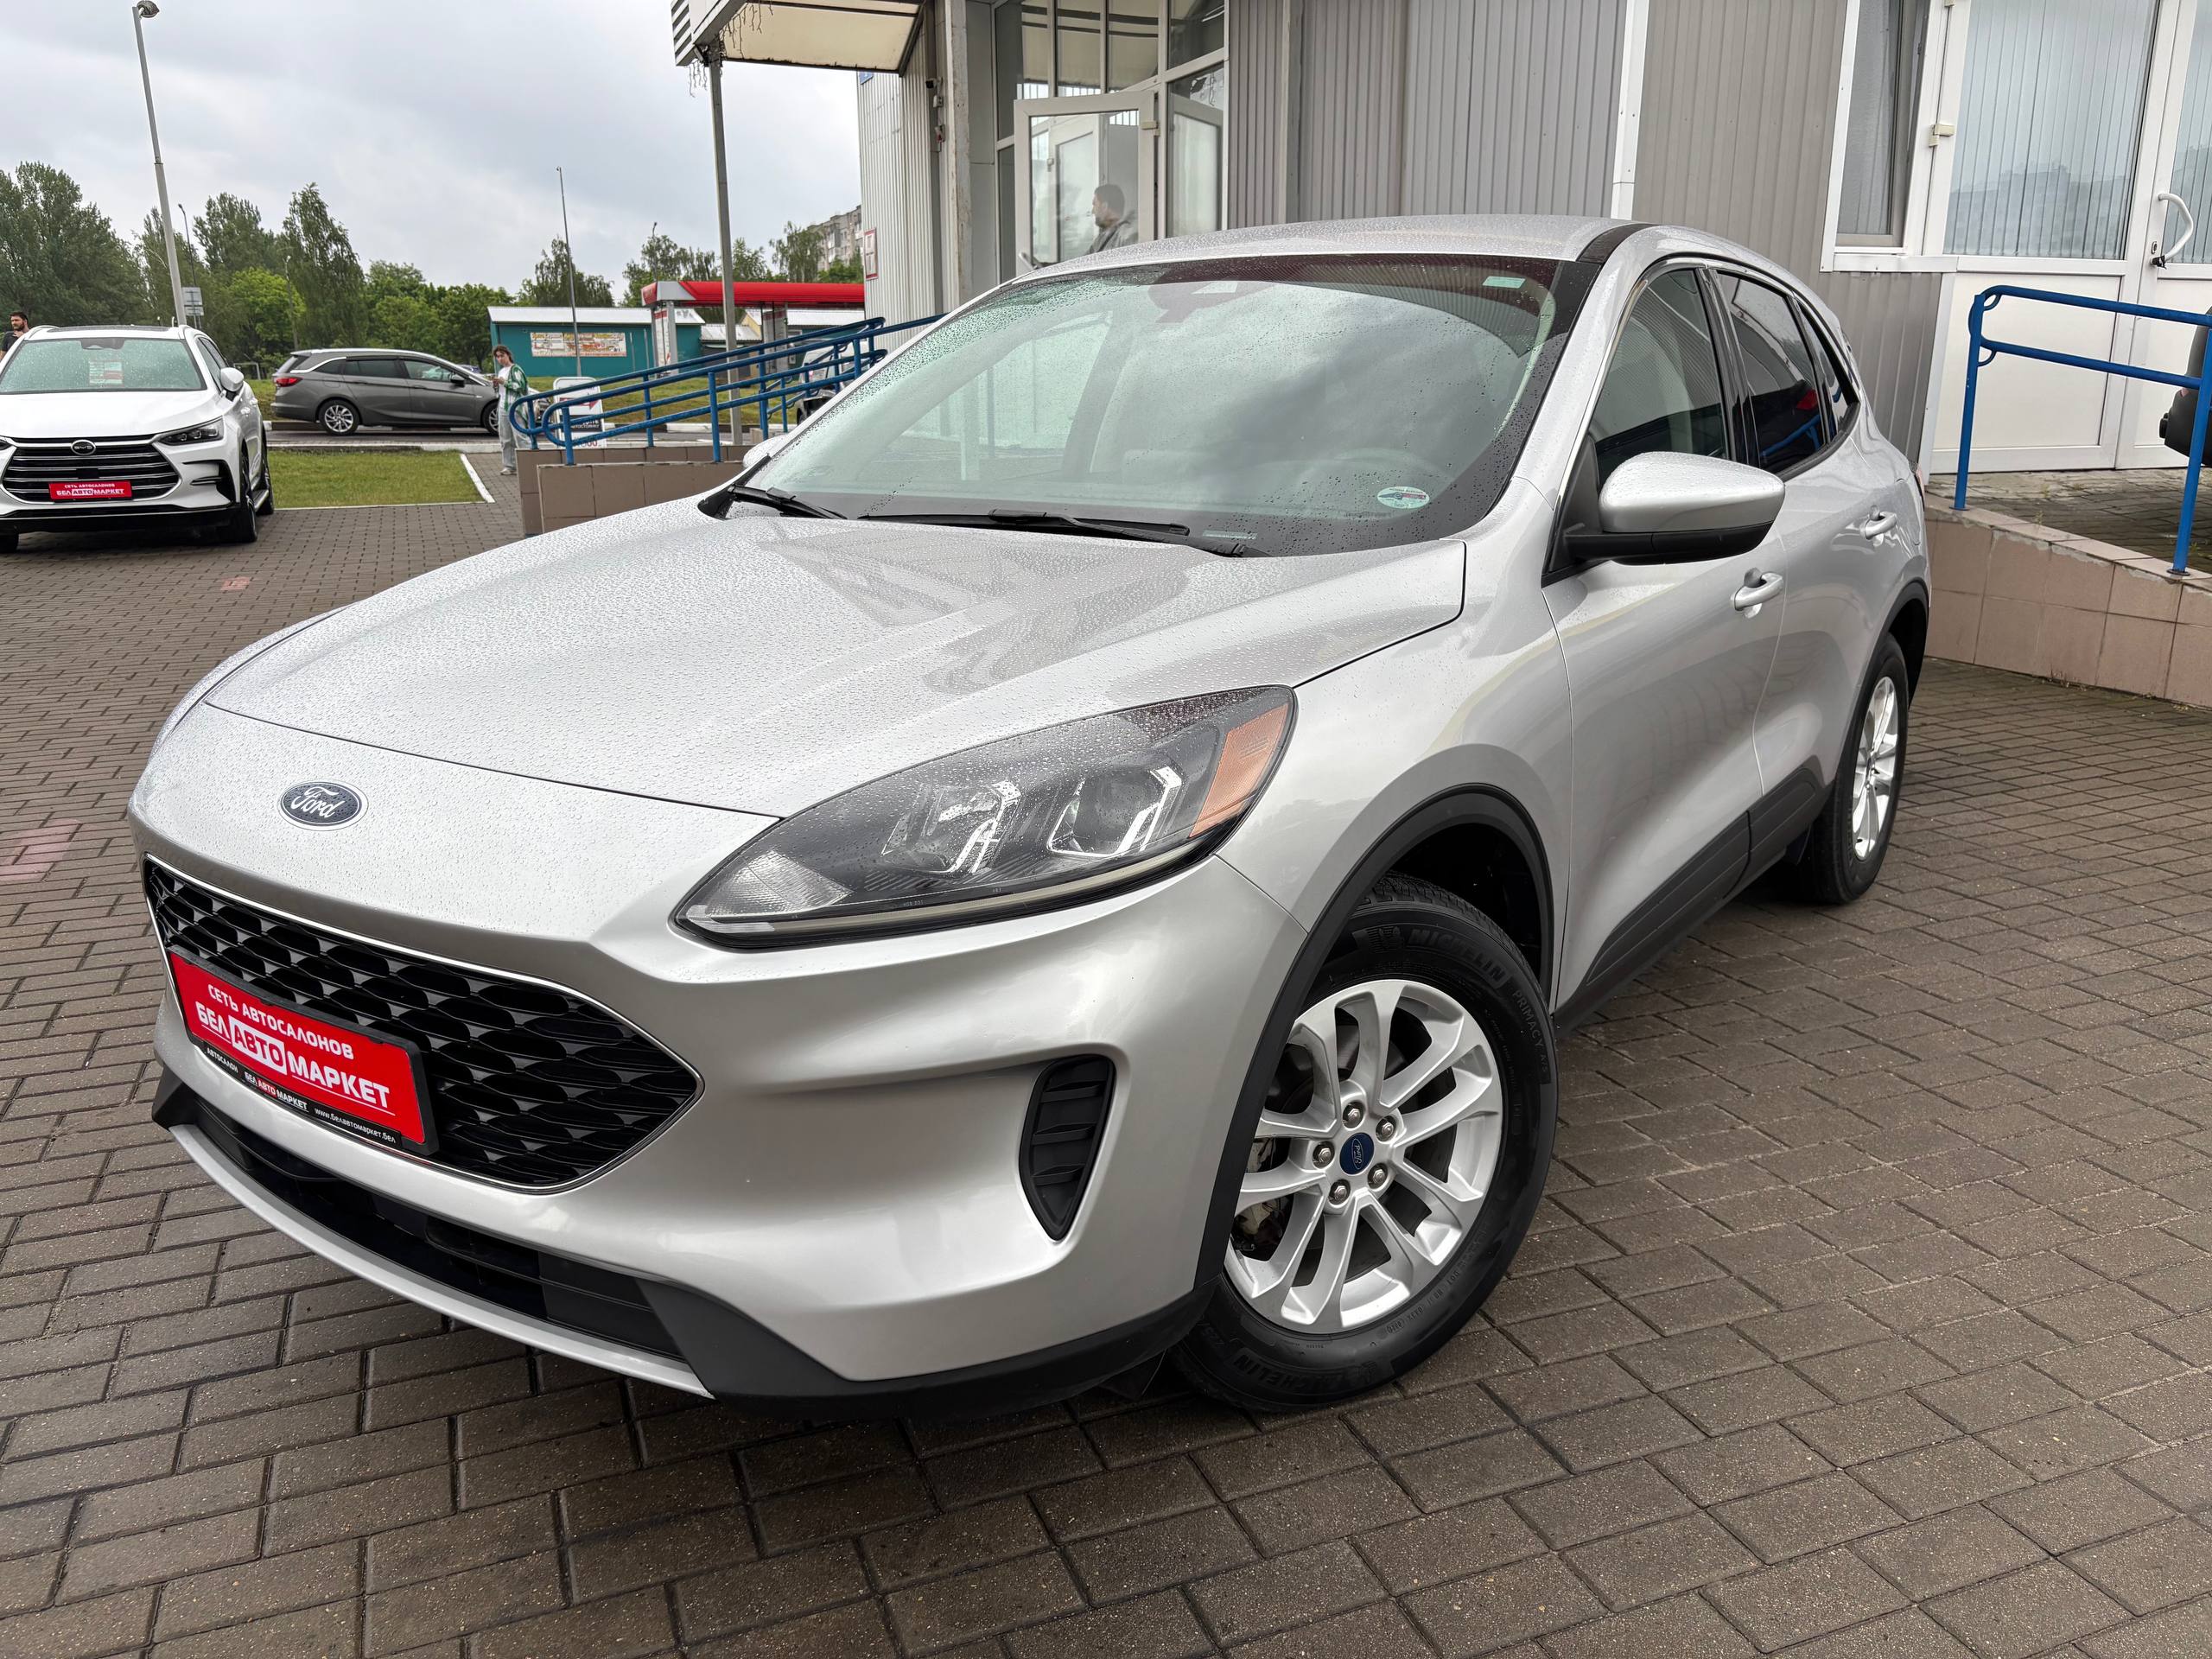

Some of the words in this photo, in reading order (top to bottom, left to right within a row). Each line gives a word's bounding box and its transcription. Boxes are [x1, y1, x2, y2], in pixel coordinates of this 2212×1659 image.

[290, 786, 346, 818] Ford
[1408, 927, 1507, 983] MICHELIN
[208, 984, 239, 1012] СЕТЬ
[242, 1002, 354, 1059] АВТОСАЛОНОВ
[1512, 990, 1547, 1048] PRIMACY
[207, 1047, 238, 1073] АВТОСАЛОН
